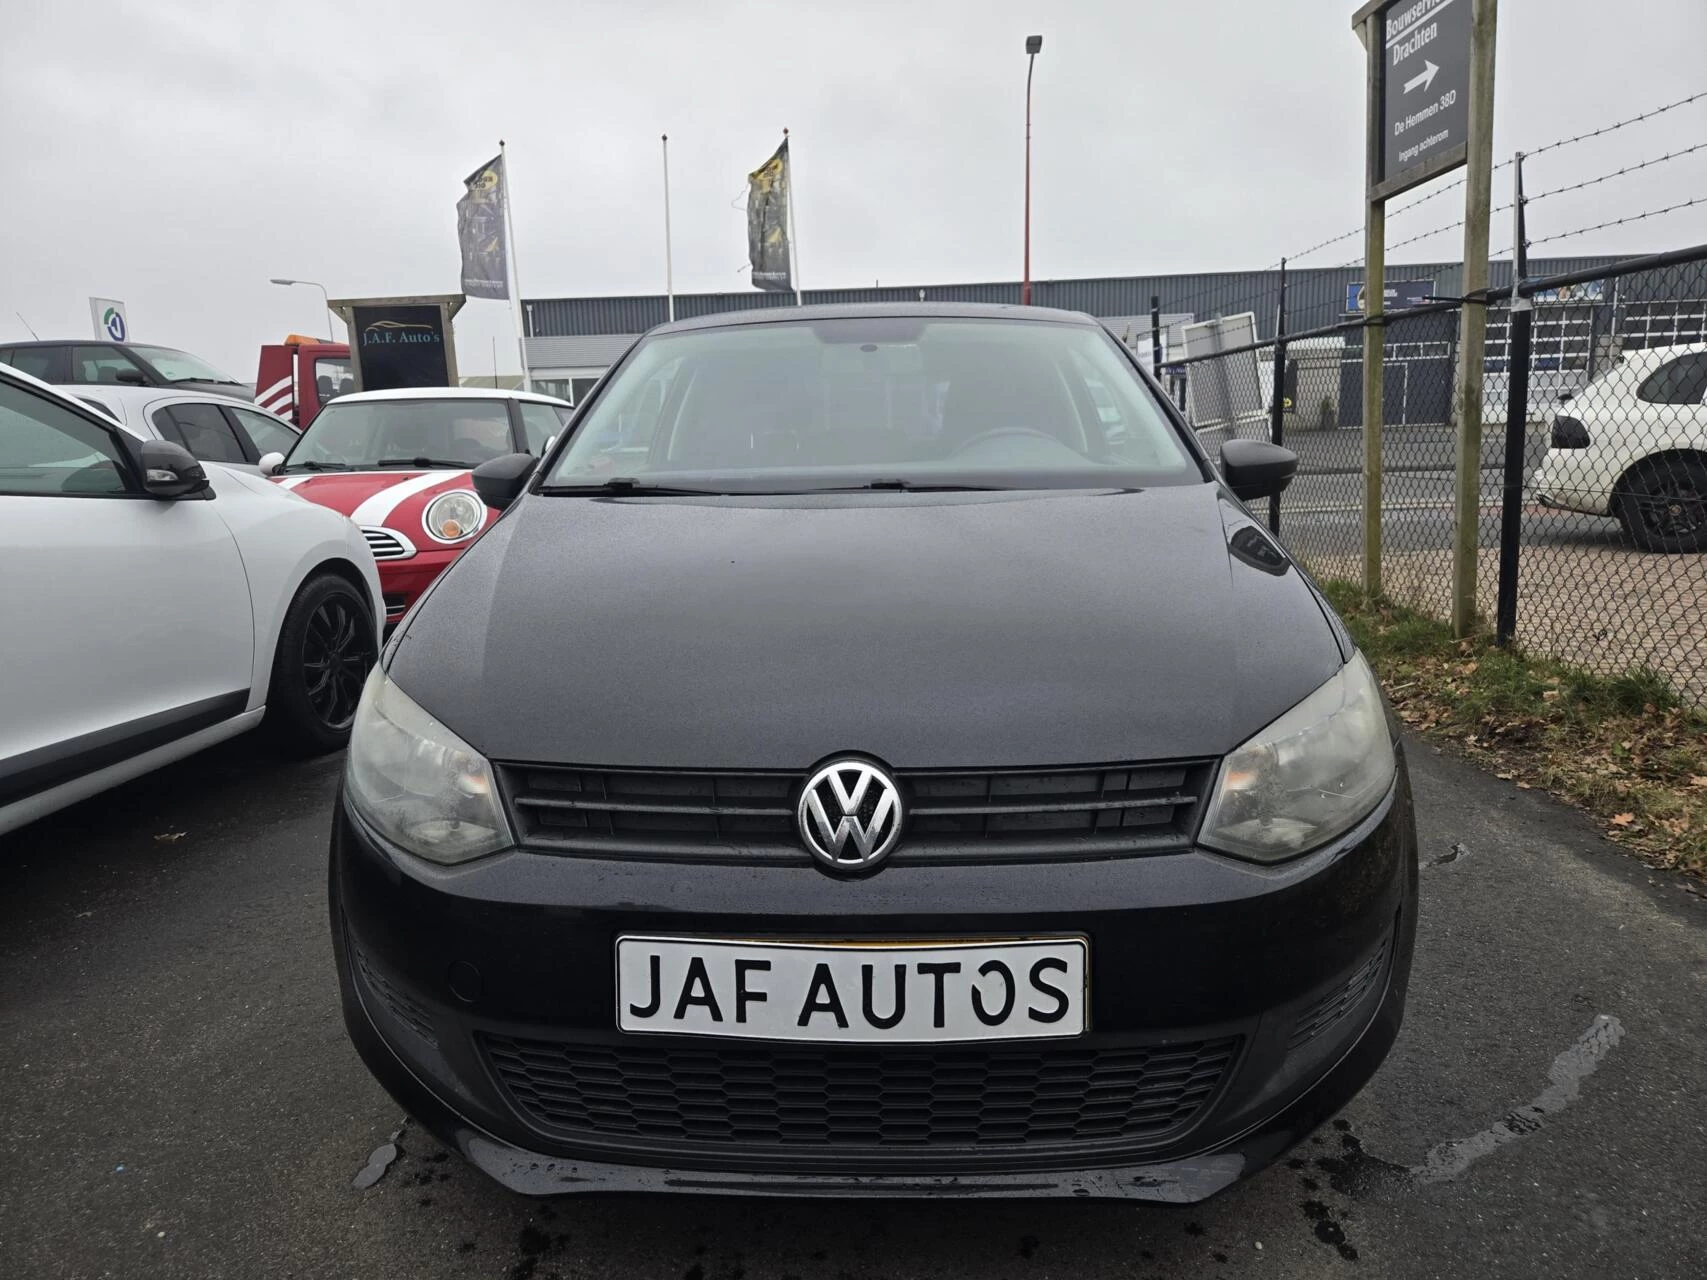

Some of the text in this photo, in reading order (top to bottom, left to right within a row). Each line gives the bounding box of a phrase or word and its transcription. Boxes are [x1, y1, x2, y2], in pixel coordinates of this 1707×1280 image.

[1393, 22, 1437, 66] Drachten
[1394, 89, 1456, 136] De Hemmen 38D
[1398, 129, 1449, 162] Ingang achterom
[363, 331, 440, 346] J.A.F. Auto's
[799, 763, 902, 866] VW
[629, 954, 1070, 1029] JAF AUTOS
